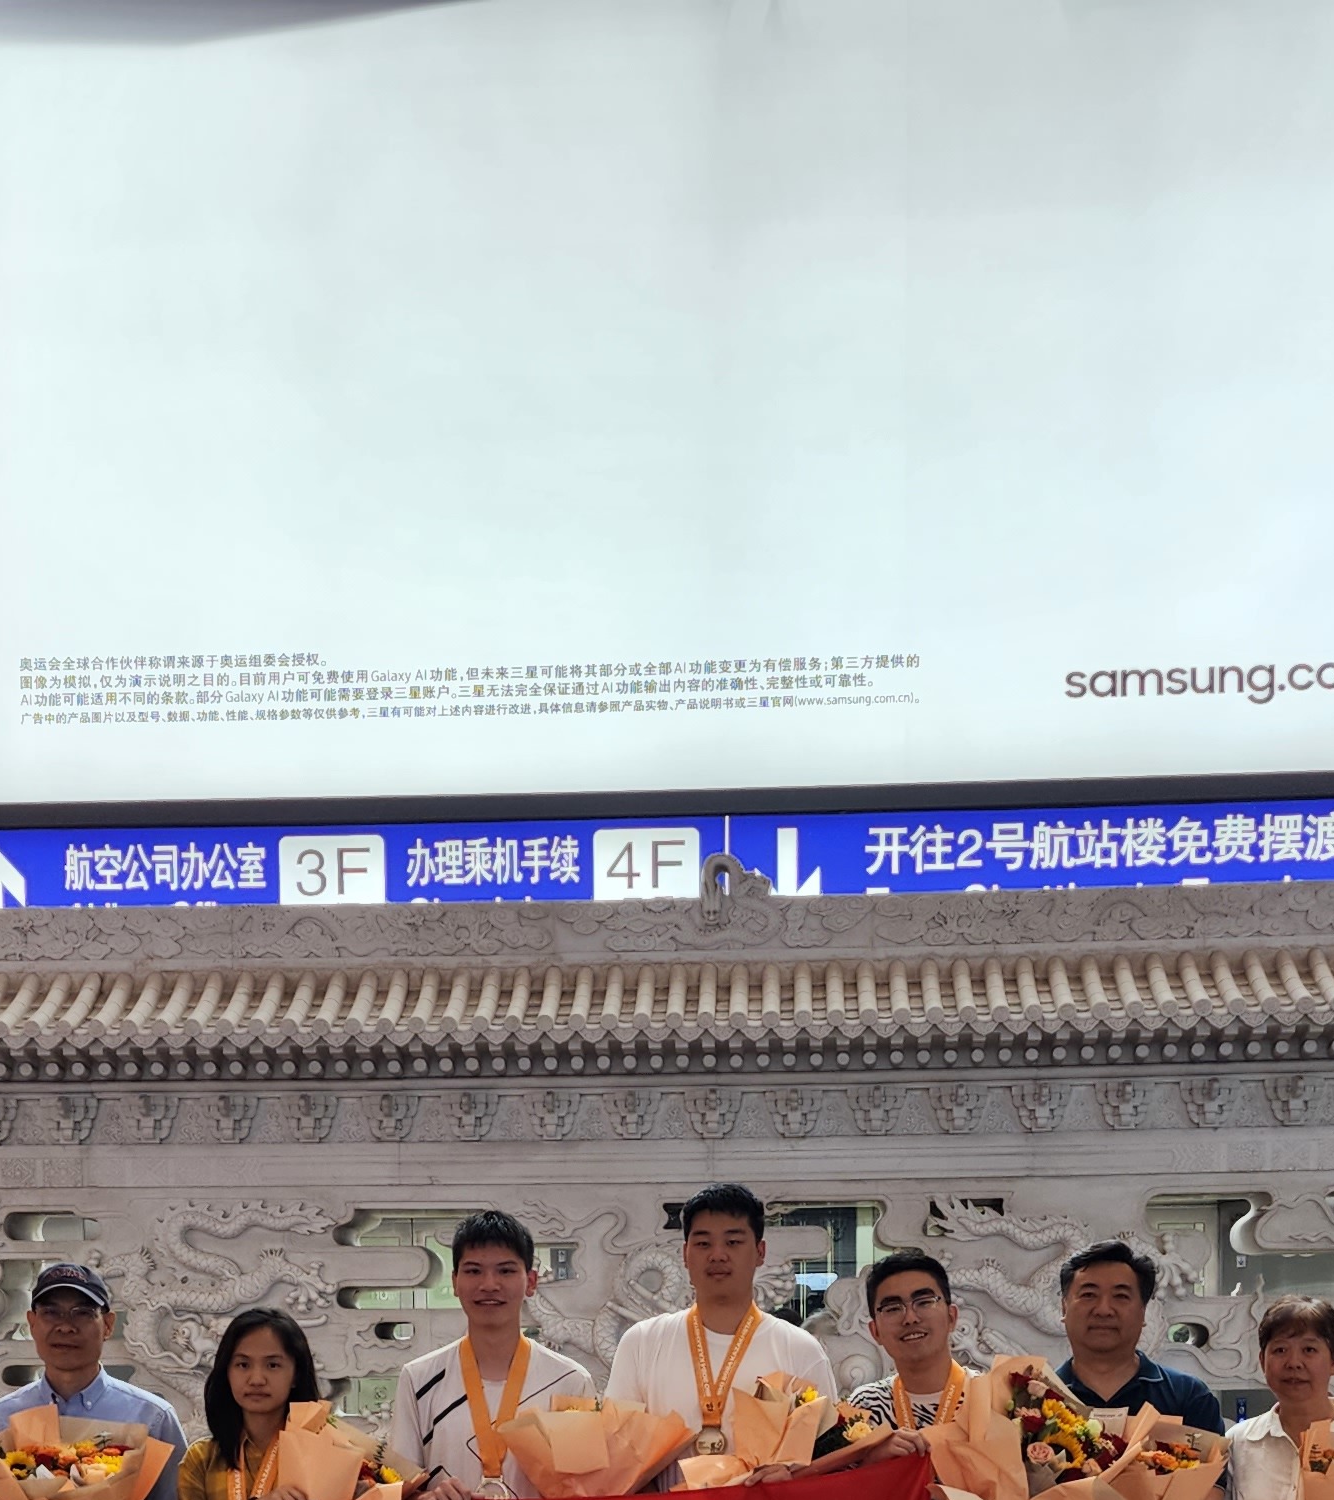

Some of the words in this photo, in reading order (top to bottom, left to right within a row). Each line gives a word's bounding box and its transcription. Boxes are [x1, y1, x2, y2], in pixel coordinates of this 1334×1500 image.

[64, 842, 267, 891] 航空公司办公室
[296, 847, 370, 896] 3F
[406, 834, 580, 887] 办理乘机手续
[606, 839, 686, 889] 4F
